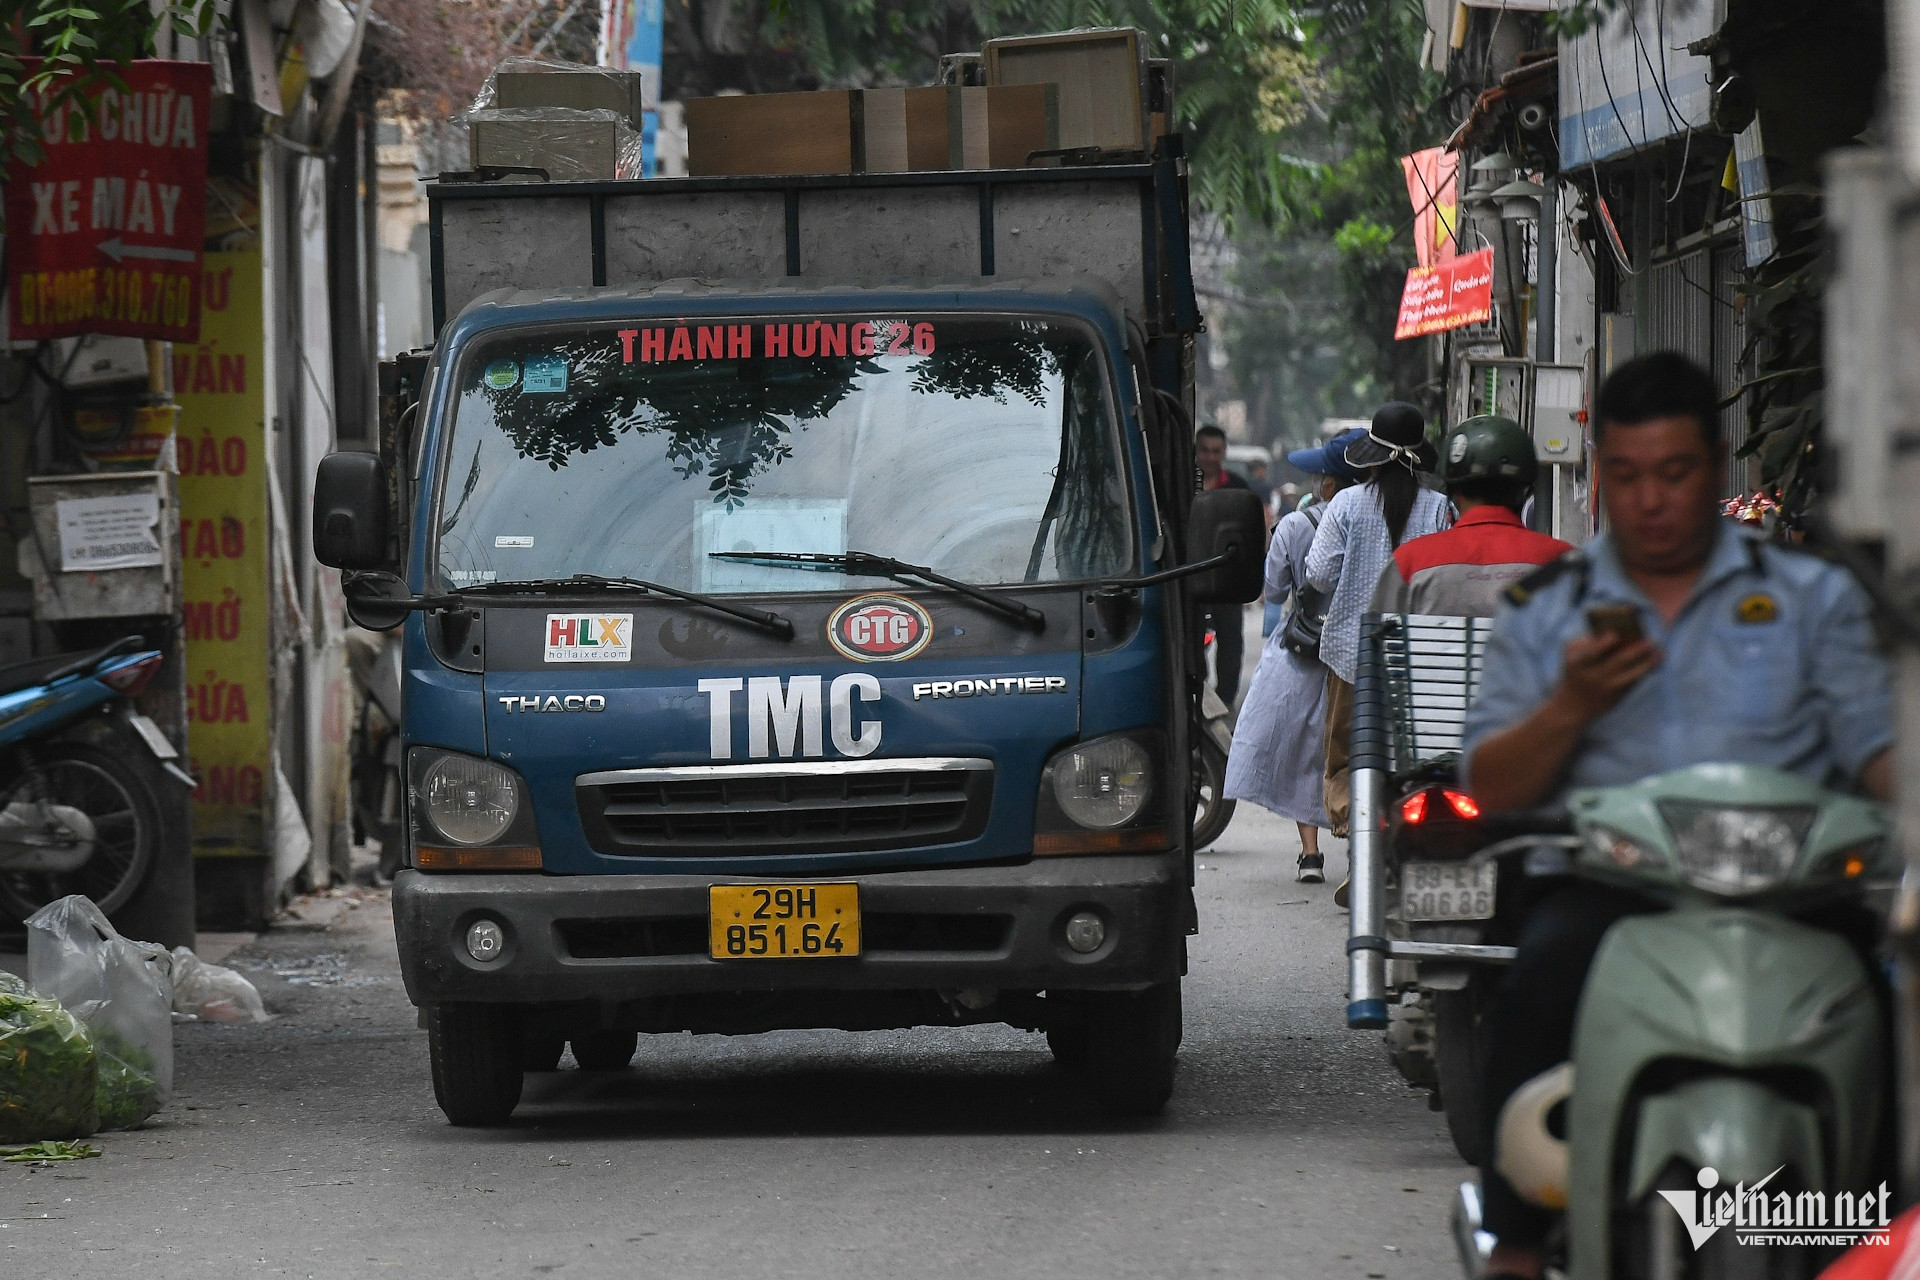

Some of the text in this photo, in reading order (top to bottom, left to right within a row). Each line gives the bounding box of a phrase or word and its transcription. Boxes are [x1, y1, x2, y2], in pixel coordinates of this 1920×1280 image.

[31, 169, 182, 236] XE MÁY
[618, 318, 936, 363] THÀNH HƯNG 26
[173, 340, 247, 395] VẤN
[183, 586, 241, 642] MỞ
[850, 614, 910, 645] CTG
[550, 618, 623, 646] HLX
[499, 695, 606, 713] THACO
[912, 676, 1067, 700] FRONTIER
[698, 673, 882, 760] TMC
[753, 888, 817, 919] 29H
[726, 923, 844, 956] 851.64
